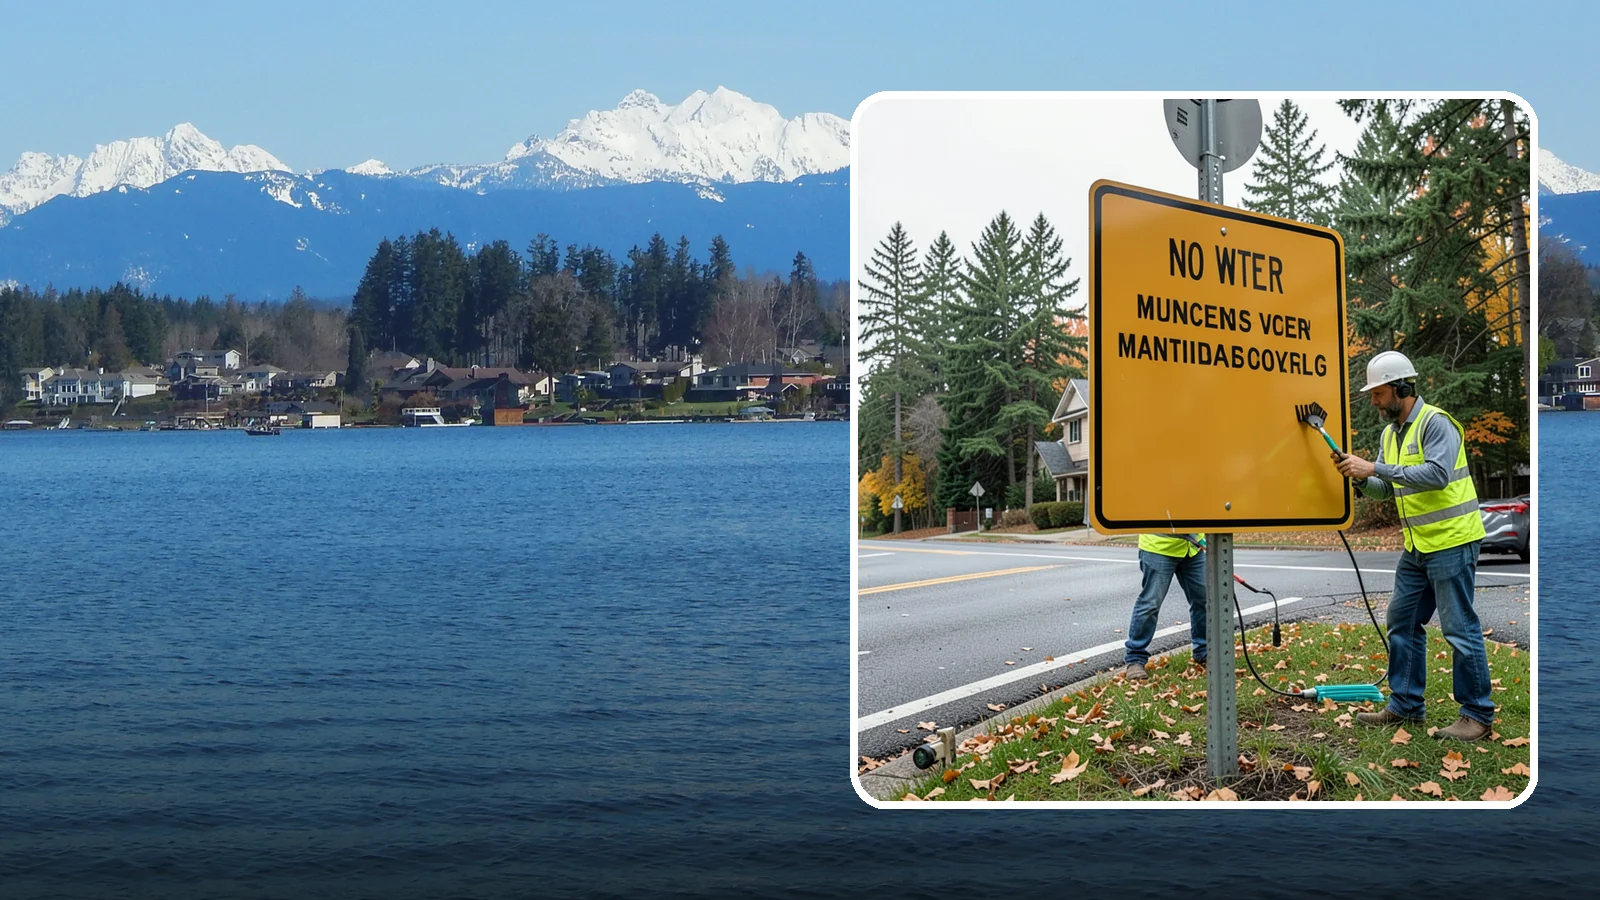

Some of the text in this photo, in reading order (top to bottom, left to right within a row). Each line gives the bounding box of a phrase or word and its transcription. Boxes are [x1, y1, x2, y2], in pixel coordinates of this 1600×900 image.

[1169, 237, 1284, 294] NO WTER
[1137, 294, 1252, 333] MUNCENS
